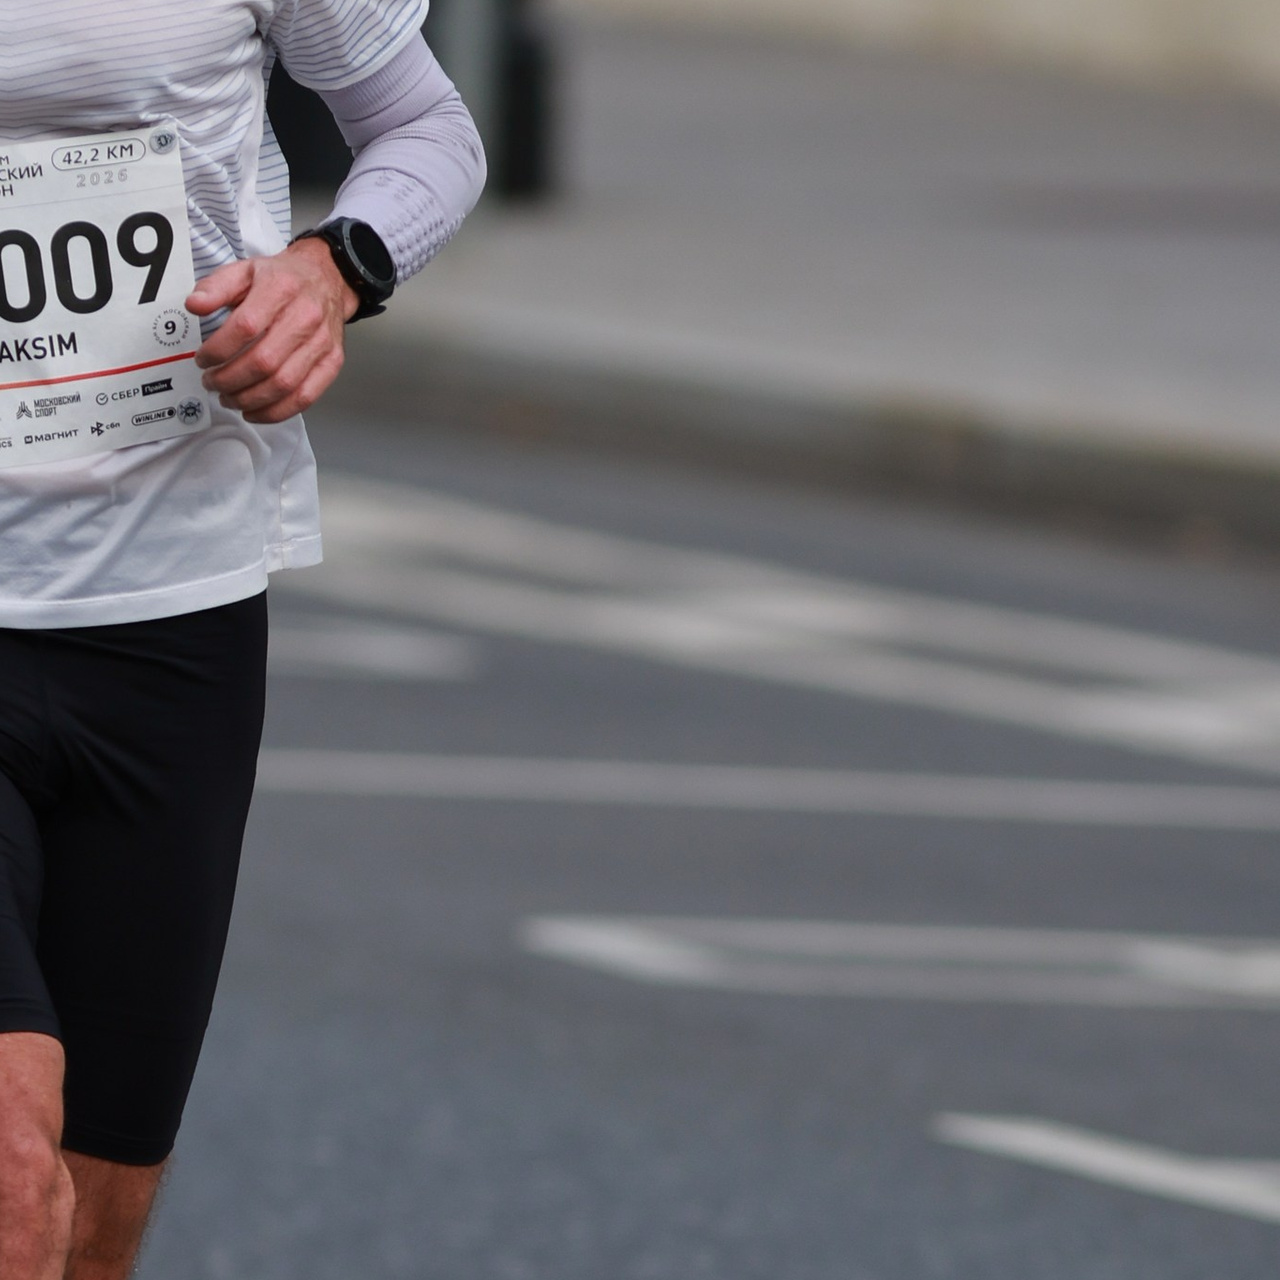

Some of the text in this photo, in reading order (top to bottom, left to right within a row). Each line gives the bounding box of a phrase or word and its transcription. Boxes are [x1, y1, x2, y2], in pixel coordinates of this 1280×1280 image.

[62, 148, 100, 165] 42,2
[76, 168, 129, 188] 2026
[164, 320, 176, 336] 9
[33, 391, 81, 408] МОСКОВСКИЙ
[111, 388, 140, 401] СБЕР
[34, 406, 57, 418] СПОРТ
[134, 411, 167, 424] WINLINE
